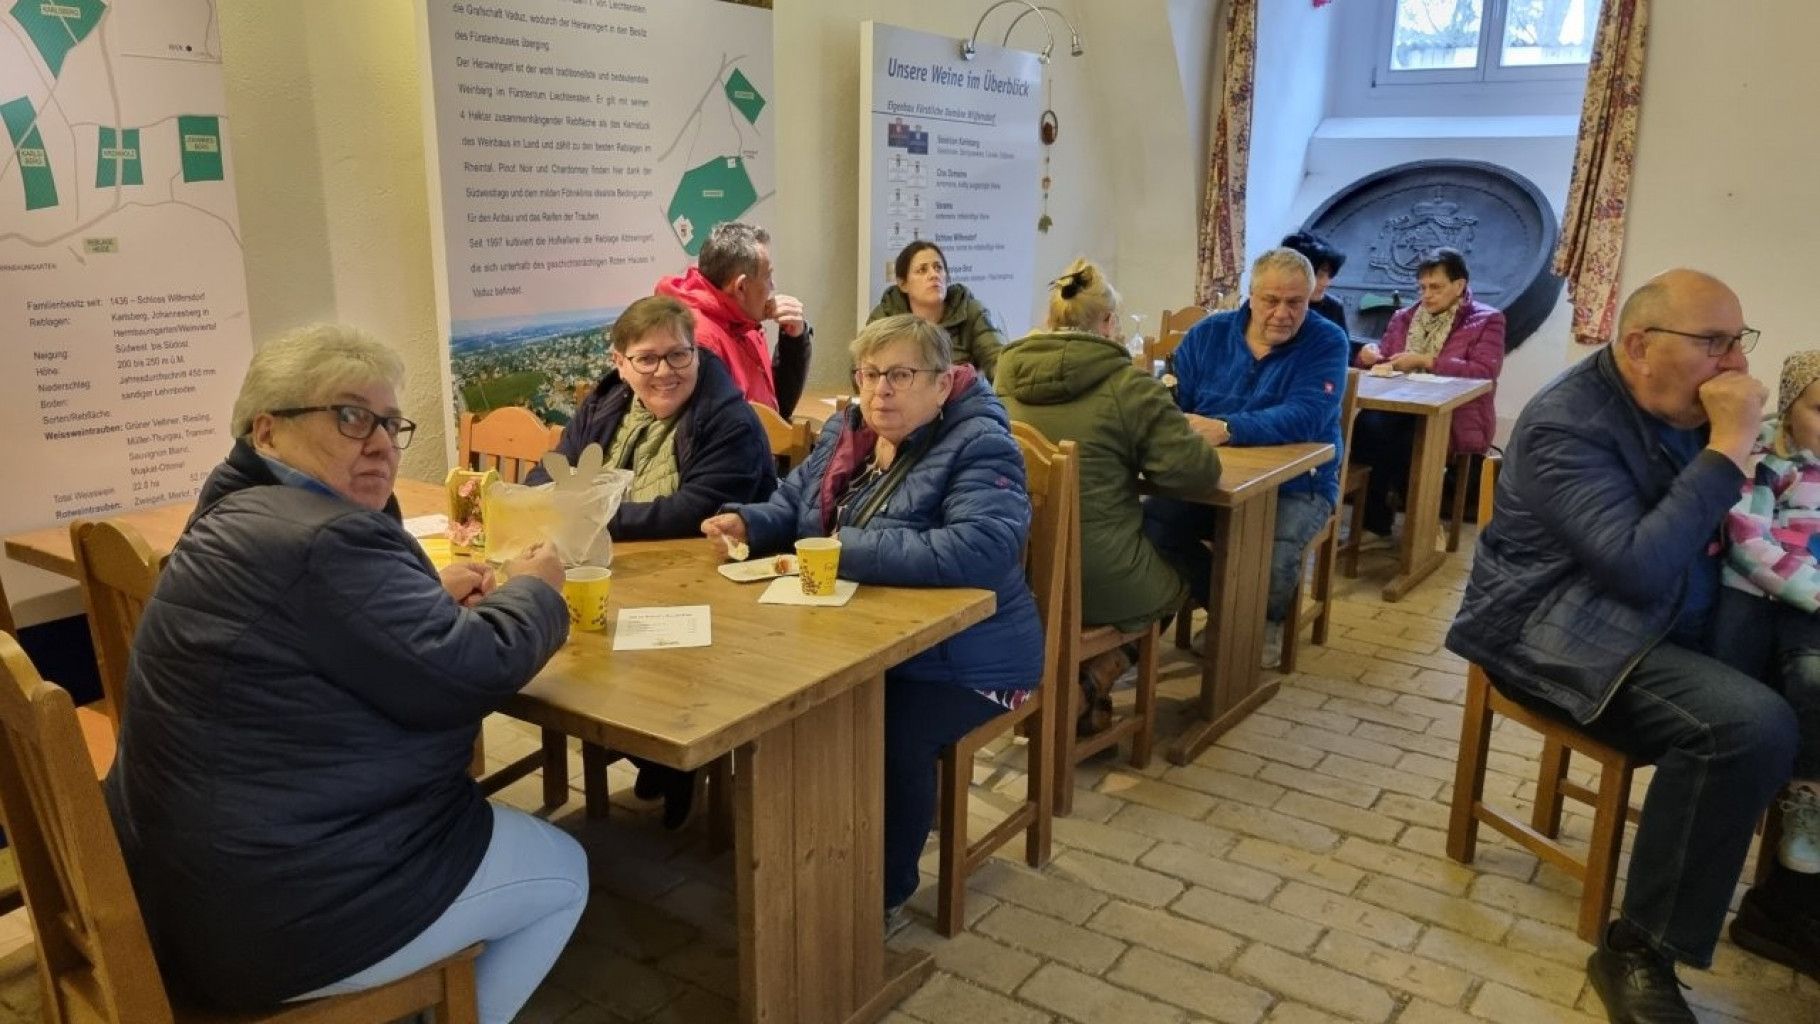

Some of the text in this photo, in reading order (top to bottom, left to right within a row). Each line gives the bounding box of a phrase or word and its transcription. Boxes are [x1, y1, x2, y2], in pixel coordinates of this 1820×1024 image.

[888, 57, 1030, 98] Unsere Weine im Überblick
